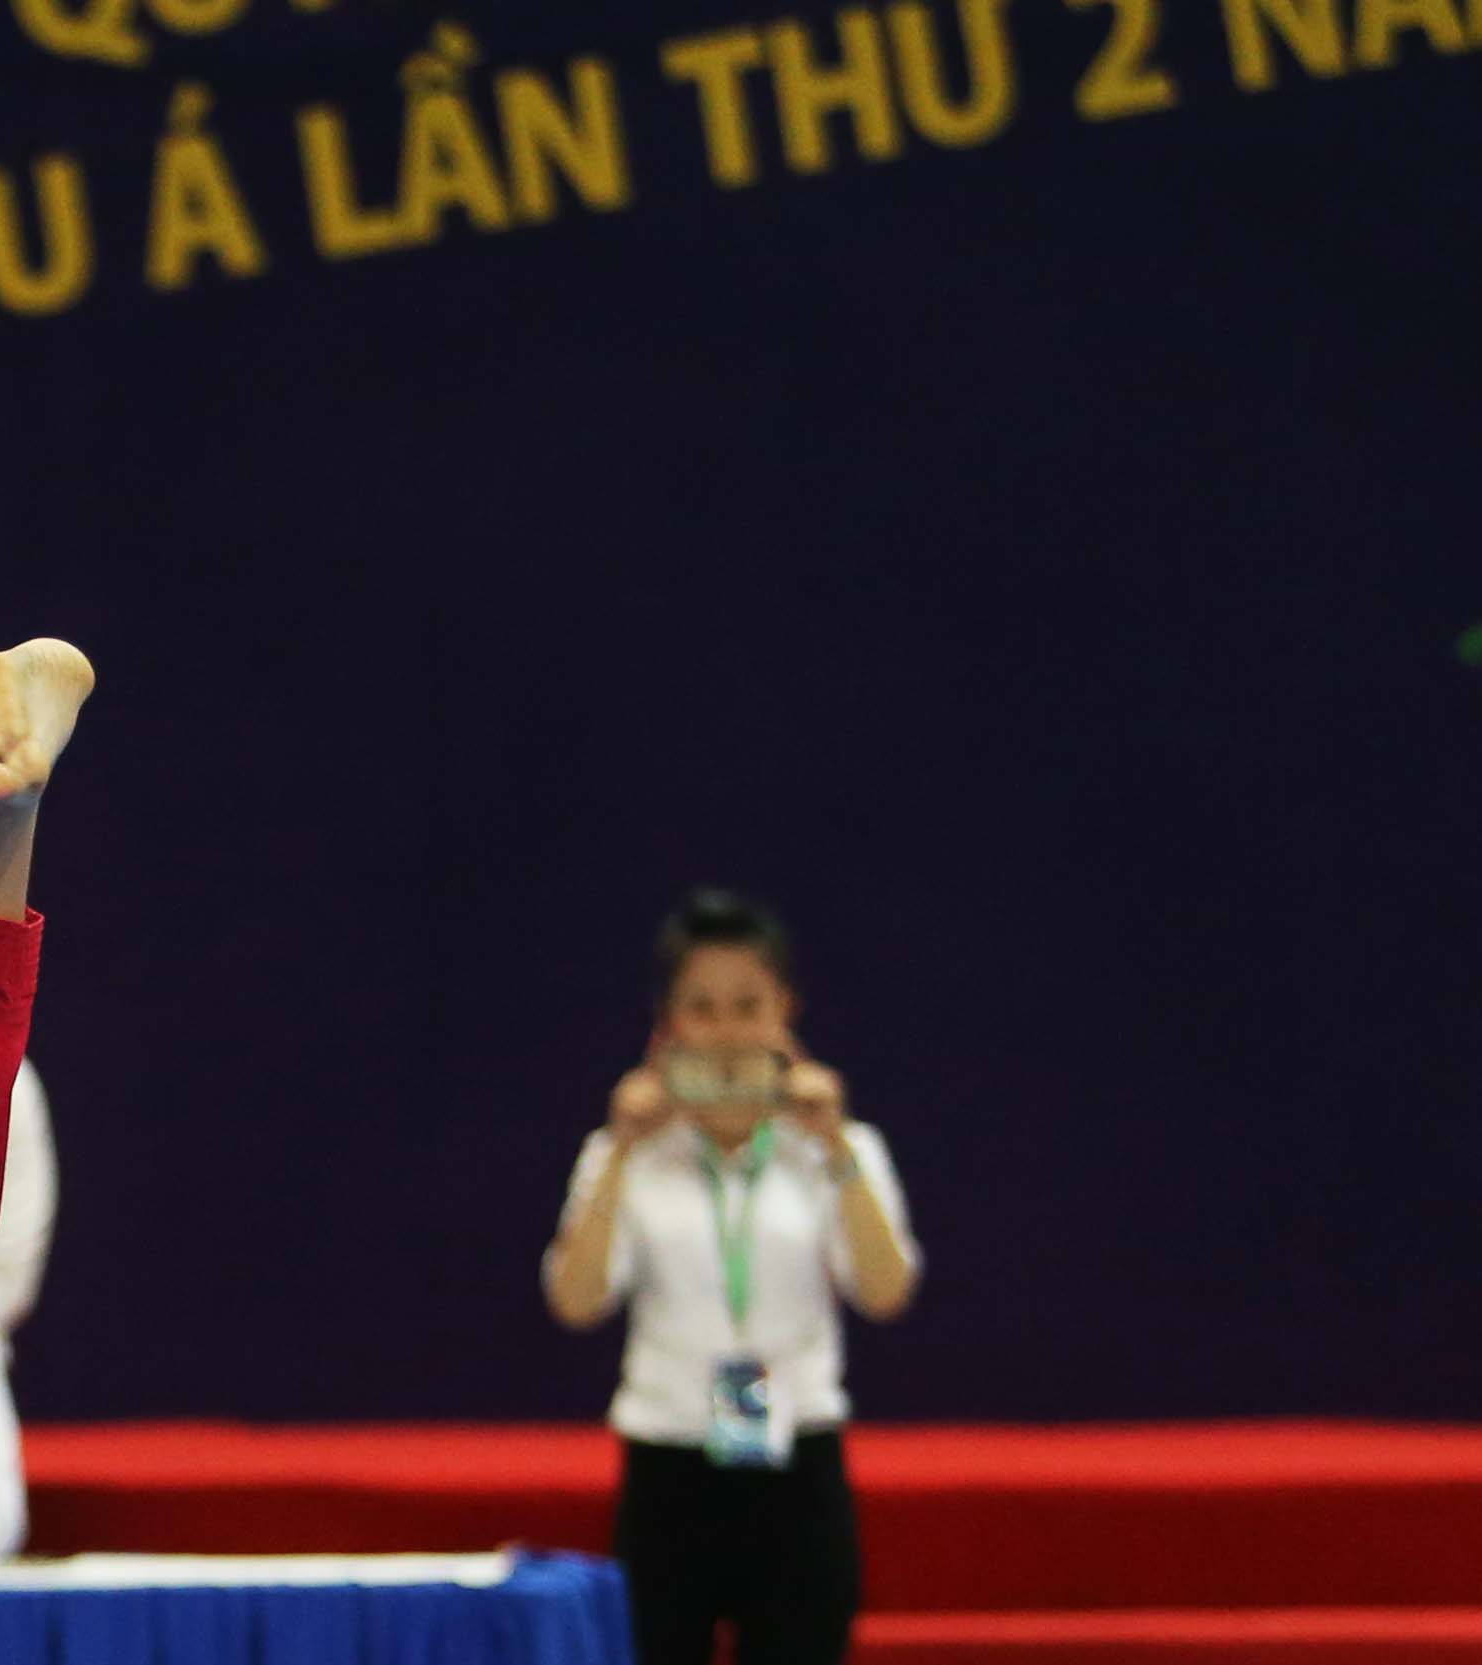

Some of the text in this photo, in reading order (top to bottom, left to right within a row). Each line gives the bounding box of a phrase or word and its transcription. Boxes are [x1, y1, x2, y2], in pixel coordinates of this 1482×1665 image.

[148, 85, 264, 286] Á
[298, 26, 628, 257] LẦN
[1065, 0, 1175, 118] 2
